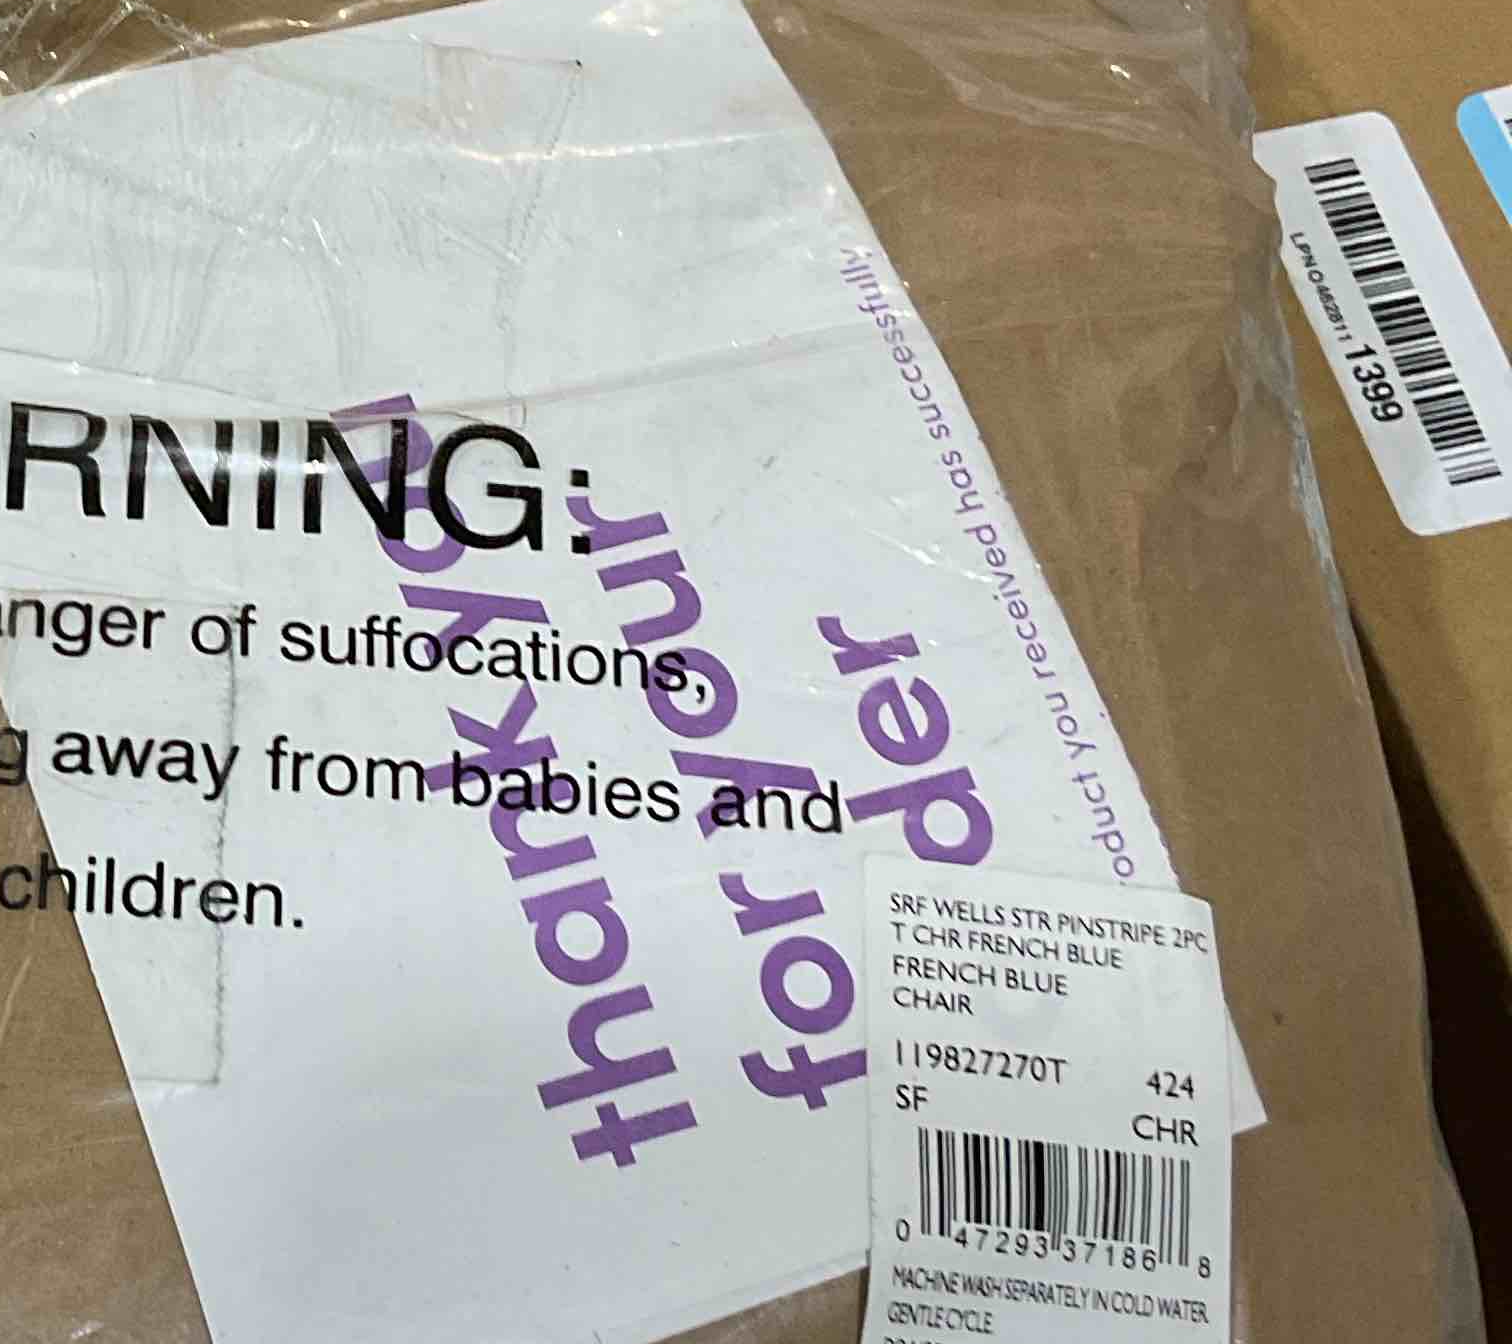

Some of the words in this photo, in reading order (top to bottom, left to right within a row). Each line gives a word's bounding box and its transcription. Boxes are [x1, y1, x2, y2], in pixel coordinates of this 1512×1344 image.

[838, 245, 951, 442] successfully
[1345, 343, 1404, 423] 1399
[940, 448, 984, 517] has
[963, 523, 1057, 682] received
[190, 604, 258, 657] of
[279, 616, 708, 704] suffocations,
[565, 496, 819, 839] your
[816, 615, 994, 867] der
[1045, 690, 1098, 761] you
[52, 730, 240, 802] away
[266, 735, 427, 801] from
[451, 751, 681, 824] babies
[710, 780, 844, 835] and
[424, 681, 698, 1169] thank
[890, 892, 928, 917] SRF
[933, 897, 1005, 928] WELLS
[1011, 906, 1053, 932] STR
[1058, 913, 1166, 947] PINSTRIPE
[1172, 926, 1209, 954] 2PC
[890, 921, 908, 943] T
[913, 924, 963, 950] CHR
[968, 931, 1059, 962] FRENCH
[1067, 943, 1125, 970] BLUE
[718, 872, 868, 1110] for
[892, 954, 997, 987] FRENCH
[1005, 968, 1069, 997] BLUE
[893, 986, 975, 1016] CHAIR
[896, 1038, 1069, 1086] 119827270T
[1145, 1069, 1196, 1101] 424
[895, 1084, 930, 1113] SF
[1131, 1113, 1200, 1148] CHR
[894, 1218, 911, 1243] 0
[953, 1226, 1049, 1260] 47293
[1061, 1239, 1158, 1273] 37186
[1198, 1256, 1211, 1280] 8
[887, 1301, 944, 1329] GENTLE
[892, 1264, 960, 1295] MACHINE
[962, 1273, 1002, 1297] WASH
[1004, 1278, 1090, 1309] SEPARATELY
[1092, 1288, 1110, 1312] IN
[1111, 1291, 1155, 1317] COLD
[1157, 1296, 1210, 1324] WATER
